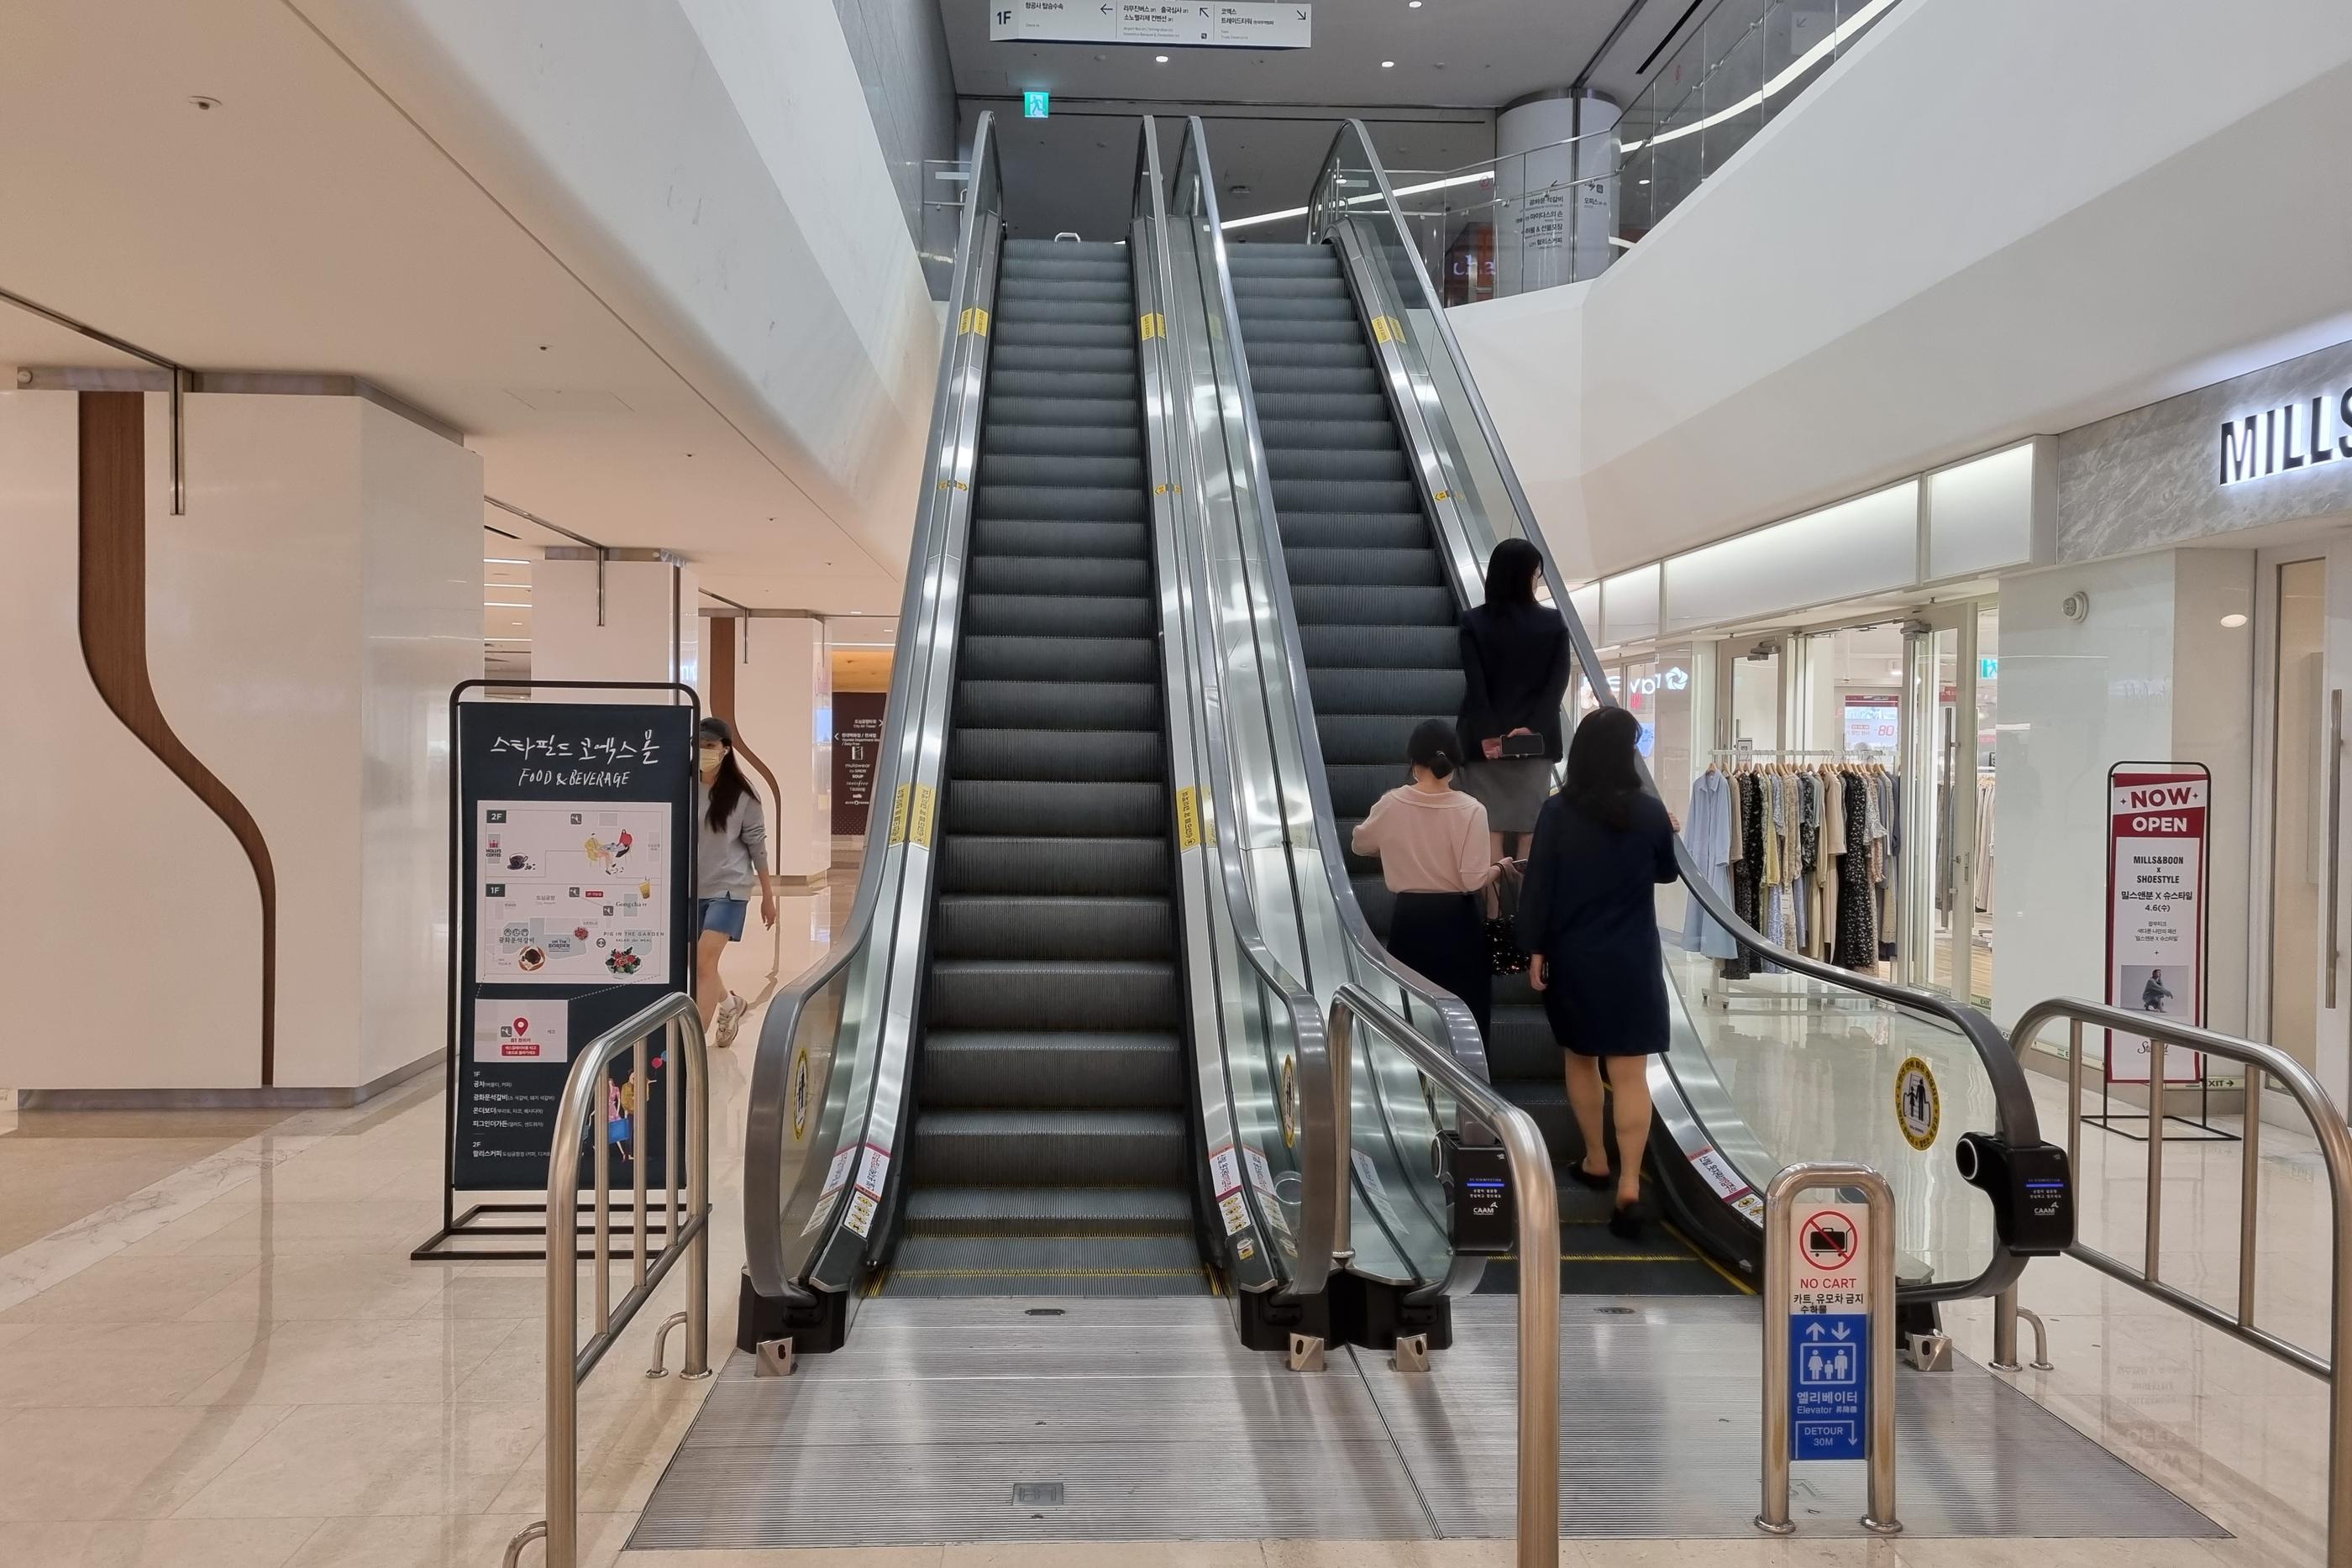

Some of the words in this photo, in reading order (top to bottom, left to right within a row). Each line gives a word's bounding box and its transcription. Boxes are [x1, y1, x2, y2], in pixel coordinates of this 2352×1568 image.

[996, 10, 1011, 25] 1F
[1536, 237, 1562, 245] 할리스커피
[490, 734, 573, 761] 스타필드
[518, 768, 552, 787] FOOD
[569, 768, 631, 788] BEVERAGE
[2130, 786, 2192, 809] NOW
[2132, 816, 2187, 832] OPEN
[2134, 856, 2184, 864] MILLS&BOON
[2136, 875, 2180, 884] SHOESTYLE
[2163, 891, 2192, 900] 슈스타일
[2145, 904, 2171, 912] 4.6(수)
[1800, 1278, 1819, 1288] NO
[1822, 1278, 1856, 1288] CART
[1793, 1293, 1814, 1304] 카트,
[1815, 1293, 1844, 1304] 유모차
[1845, 1293, 1863, 1304] 금지
[1800, 1305, 1827, 1314] 수하물
[1797, 1391, 1858, 1404] 엘리베이터
[1797, 1406, 1832, 1414] Elevator
[1804, 1427, 1843, 1435] DETOUR
[1814, 1437, 1834, 1445] 30M
